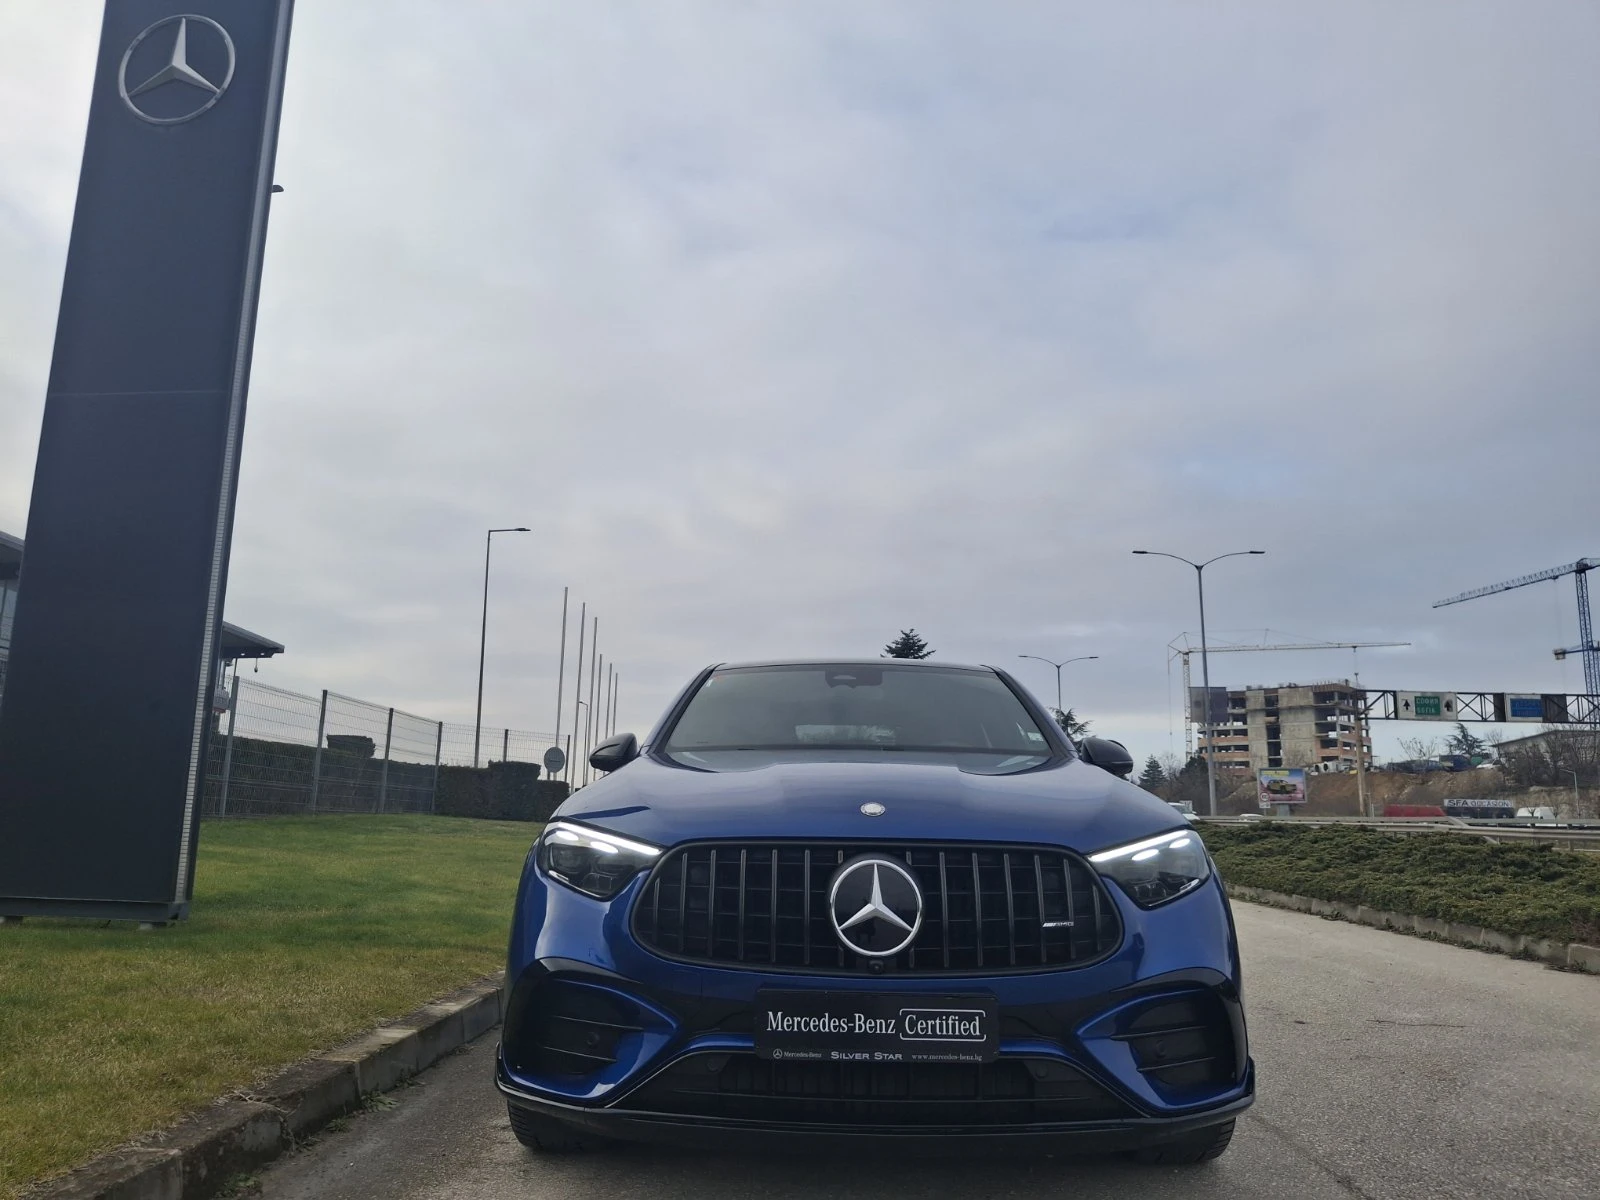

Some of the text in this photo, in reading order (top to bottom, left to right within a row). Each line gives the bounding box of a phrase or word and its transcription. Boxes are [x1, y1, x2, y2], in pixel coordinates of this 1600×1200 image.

[1448, 800, 1468, 808] SFA
[766, 1011, 981, 1036] Mercedes-Benz Certified
[830, 1051, 903, 1060] SILVER STAR
